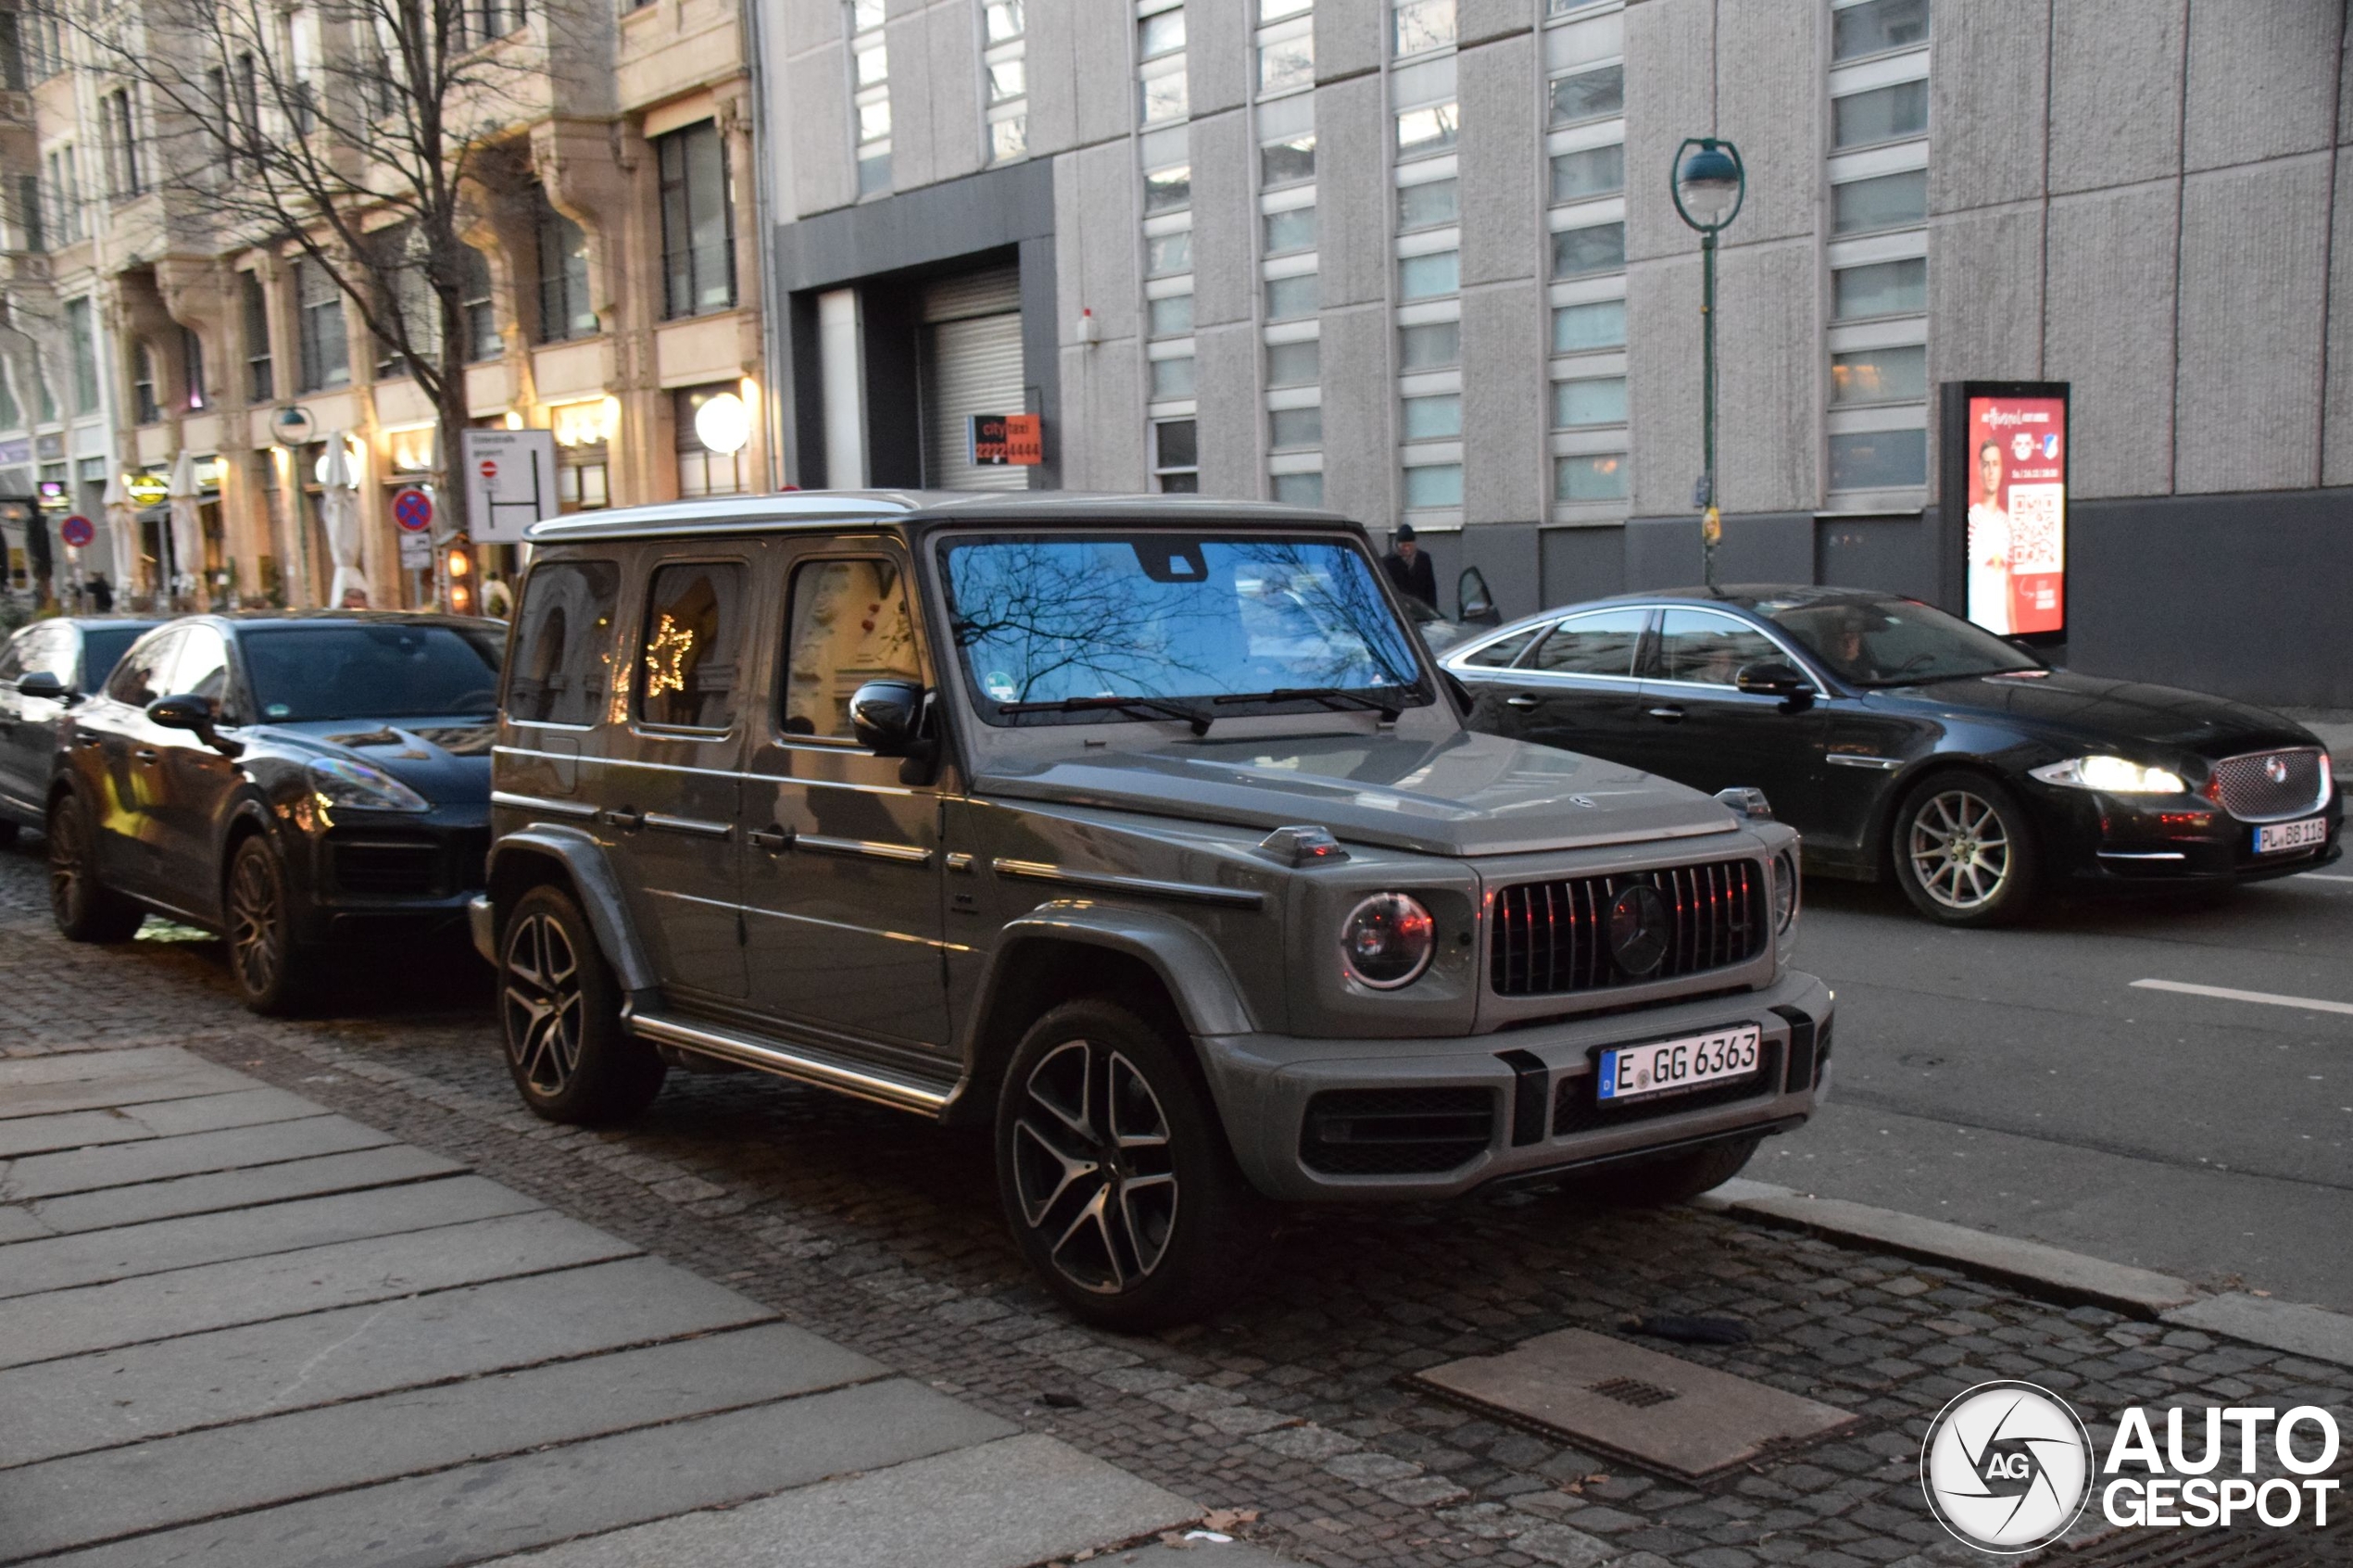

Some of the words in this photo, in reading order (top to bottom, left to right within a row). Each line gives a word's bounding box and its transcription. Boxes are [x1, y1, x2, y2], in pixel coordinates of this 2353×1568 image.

[983, 422, 1005, 437] city
[976, 443, 1007, 458] 2222
[1008, 443, 1039, 456] 4444
[2261, 830, 2278, 847] PL
[2285, 826, 2301, 845] BB
[1617, 1053, 1635, 1090] E
[1653, 1045, 1688, 1084] GG
[1693, 1033, 1757, 1076] 6363
